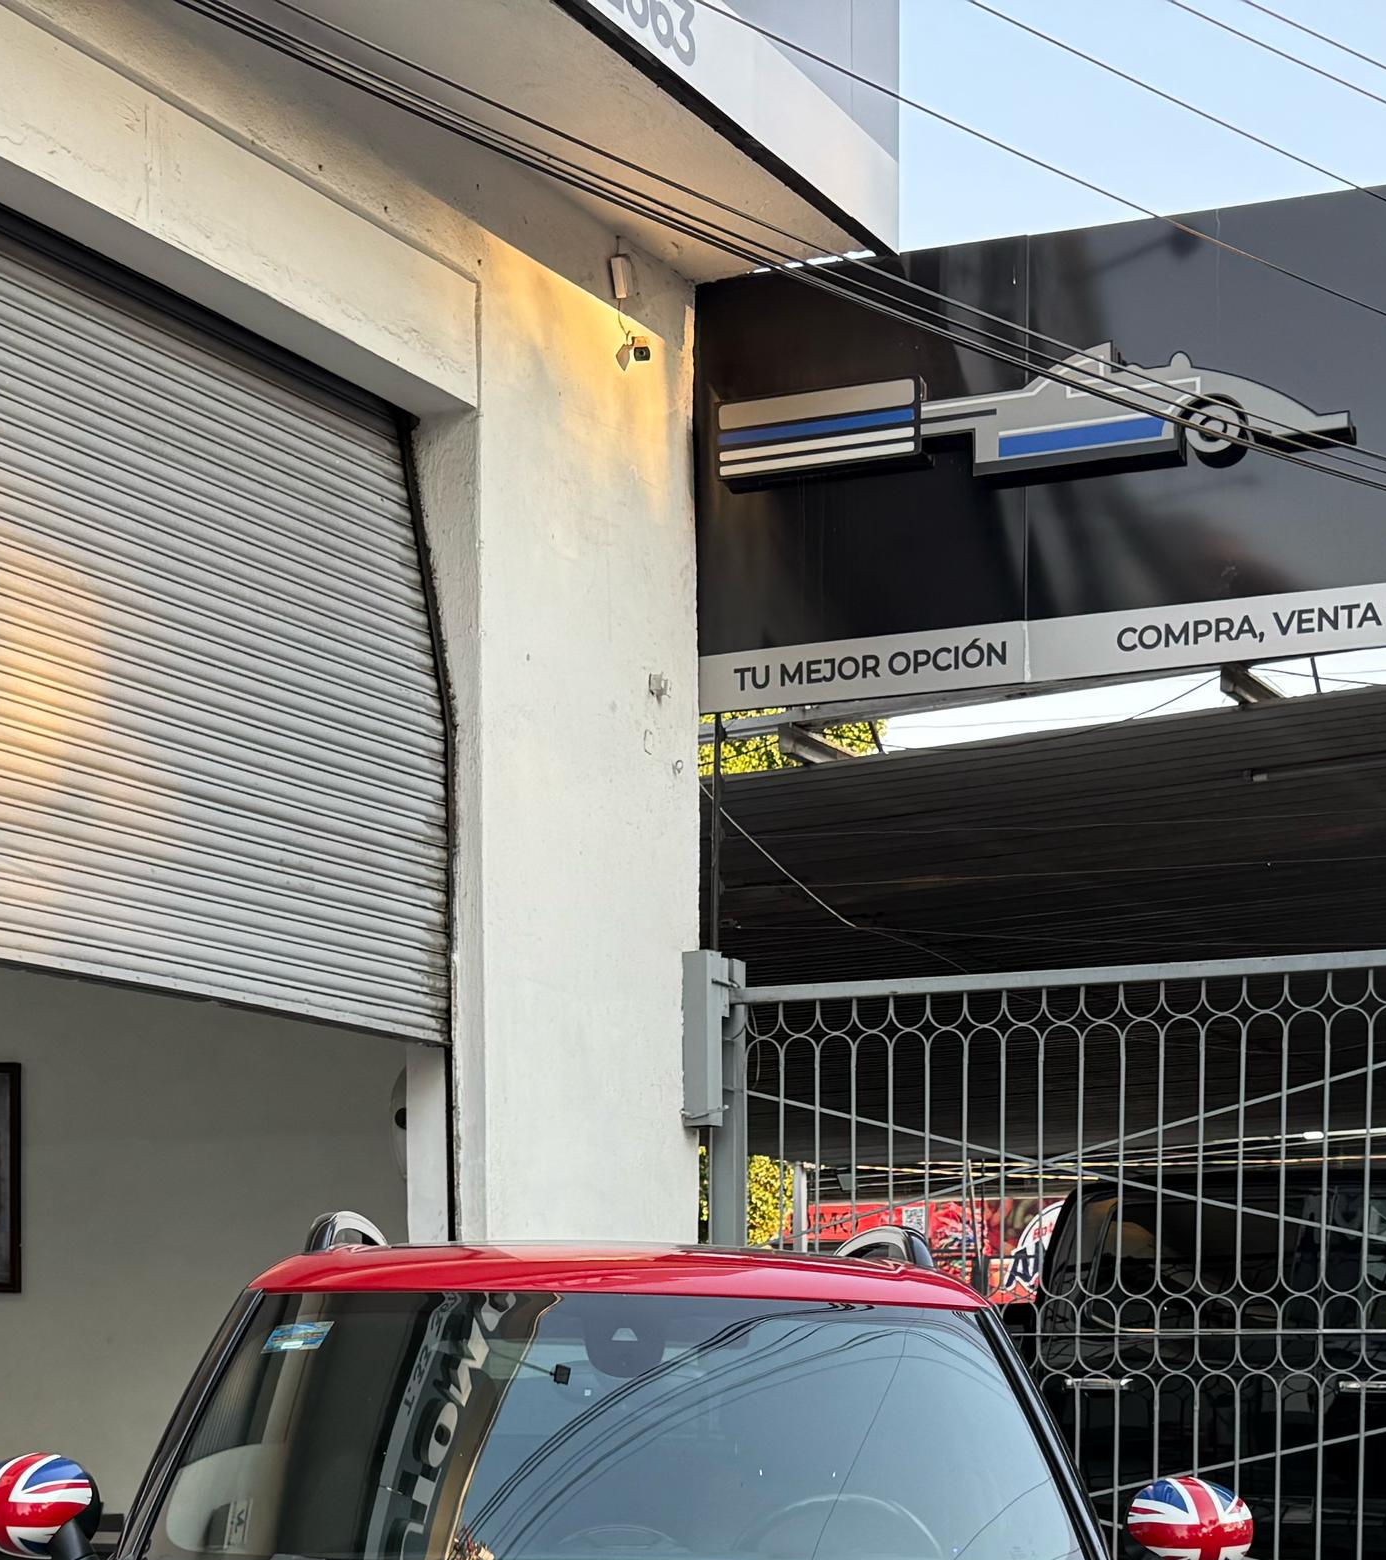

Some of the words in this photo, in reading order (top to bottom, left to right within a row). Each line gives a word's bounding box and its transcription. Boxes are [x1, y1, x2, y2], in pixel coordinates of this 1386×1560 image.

[1116, 614, 1266, 653] COMPRA,
[1272, 602, 1383, 636] VENTA
[733, 665, 770, 692] TU
[780, 654, 881, 687] MEJOR
[887, 637, 1008, 676] OPCIÓN
